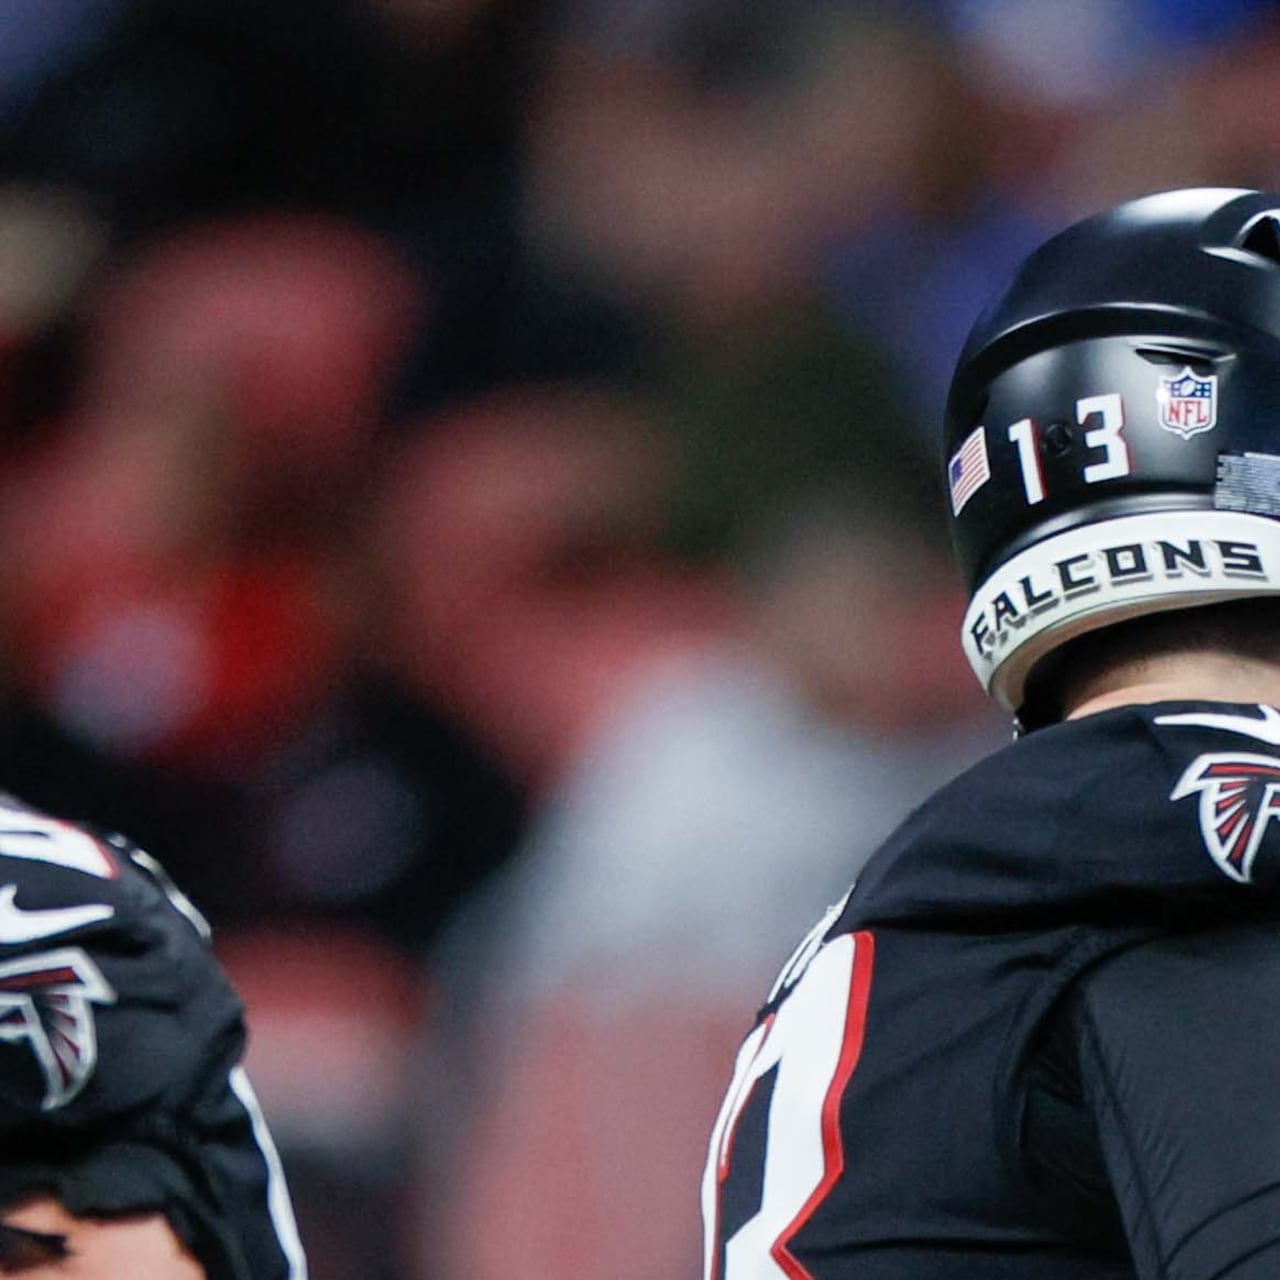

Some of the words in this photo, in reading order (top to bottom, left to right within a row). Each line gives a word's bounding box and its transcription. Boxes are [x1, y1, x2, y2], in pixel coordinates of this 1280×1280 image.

[1008, 392, 1133, 505] 13
[1168, 400, 1208, 427] NFL
[969, 538, 1266, 662] FALCONS
